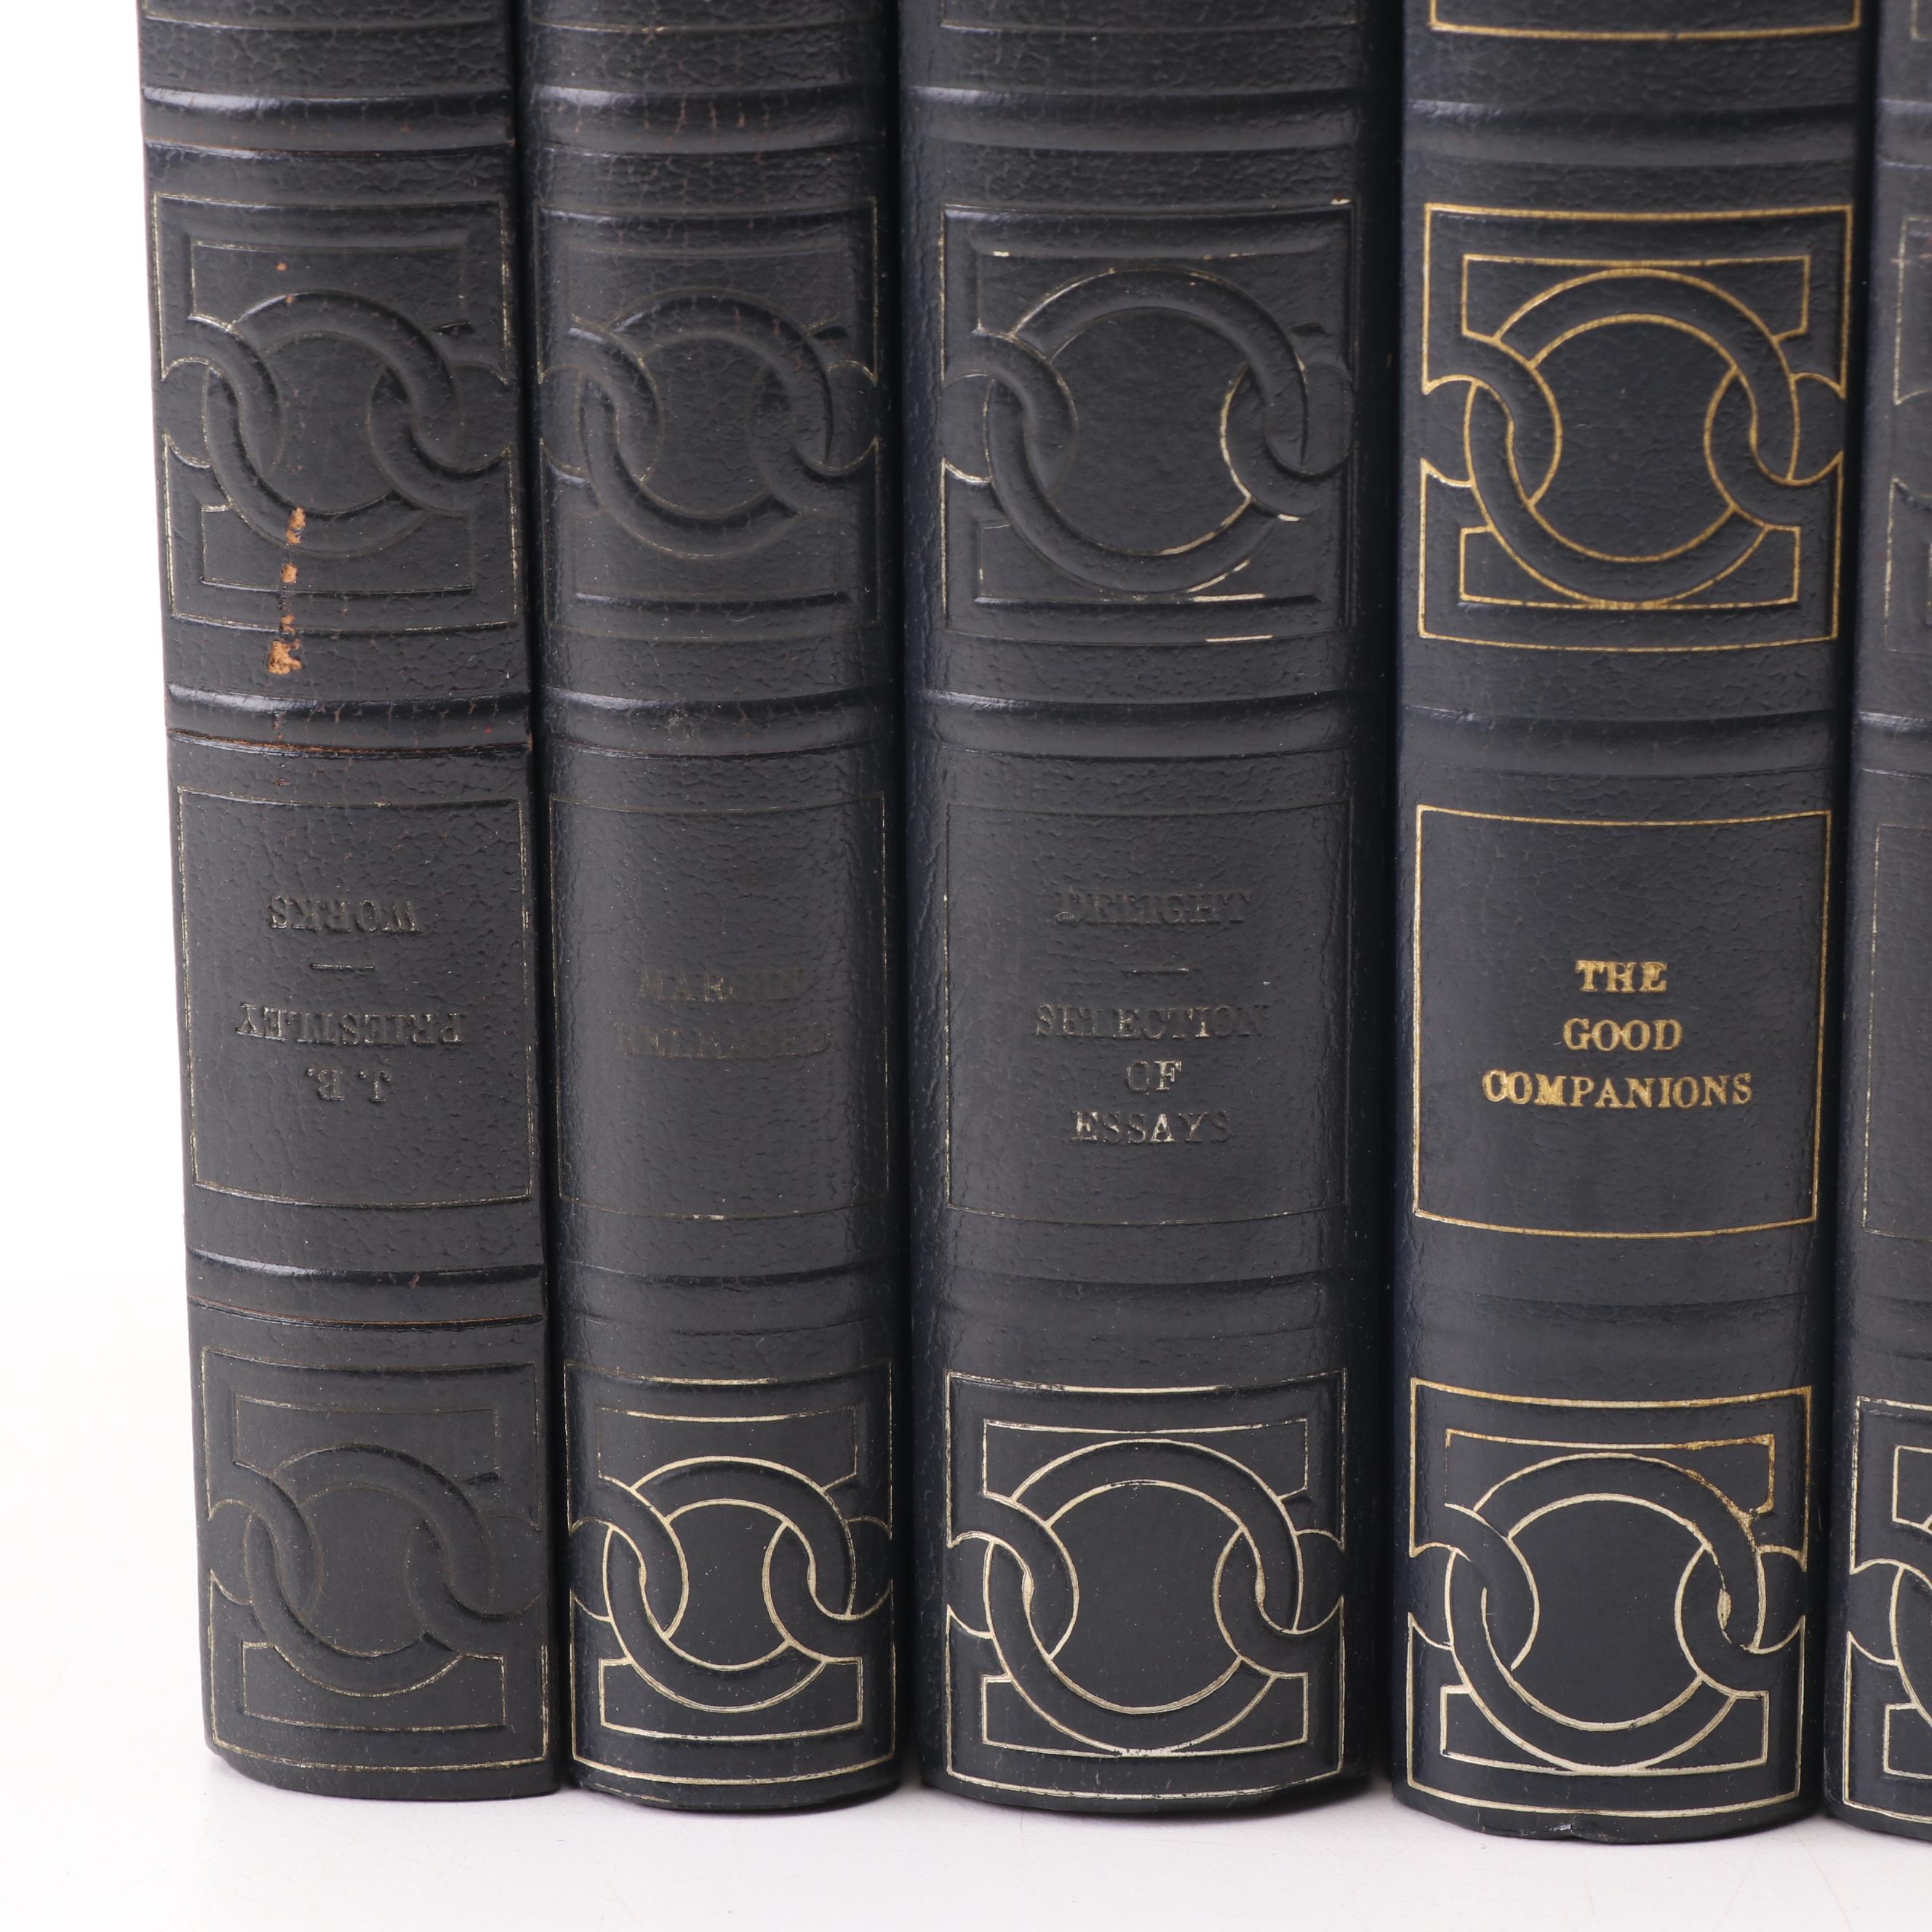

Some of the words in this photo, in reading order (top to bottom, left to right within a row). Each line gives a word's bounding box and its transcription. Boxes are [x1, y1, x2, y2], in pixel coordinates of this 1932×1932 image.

[268, 893, 423, 934] WORKS
[1574, 959, 1668, 993] THE
[236, 1002, 466, 1046] PRIESTLEY
[1562, 1018, 1682, 1052] GOOD
[1125, 1059, 1182, 1093] OF
[1482, 1069, 1753, 1109] COMPANIONS
[1069, 1110, 1232, 1145] ESSAYS
